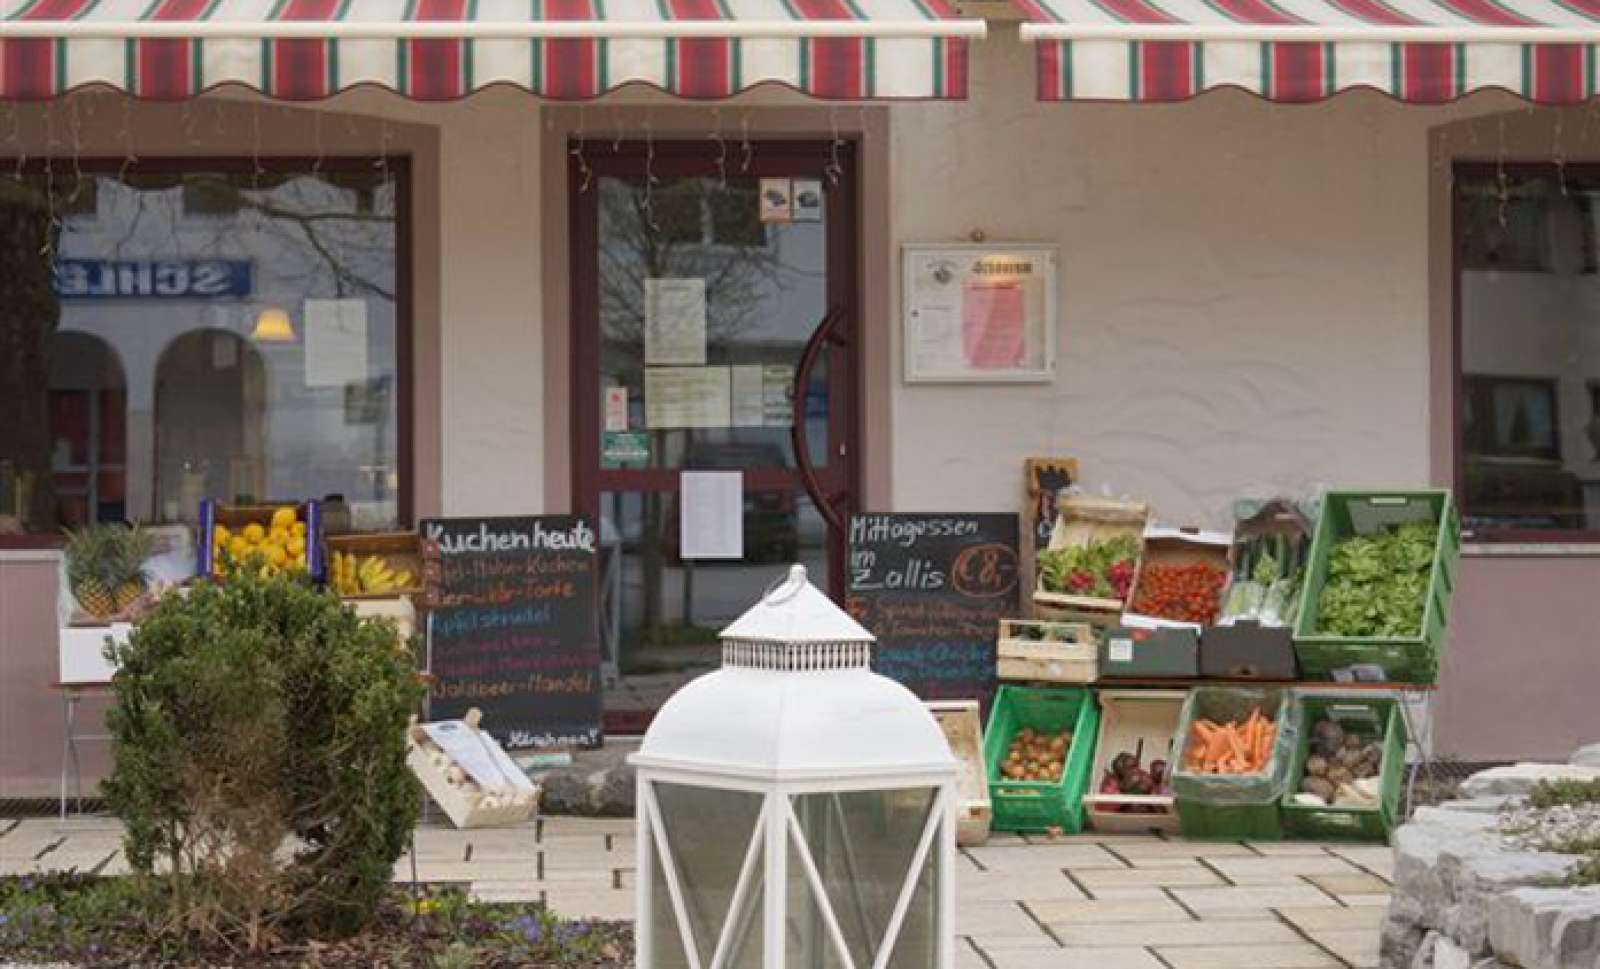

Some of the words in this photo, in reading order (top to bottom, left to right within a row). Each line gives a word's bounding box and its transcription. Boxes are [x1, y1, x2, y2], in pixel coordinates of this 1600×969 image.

[427, 521, 529, 553] Kuchen
[533, 519, 596, 552] heute
[849, 516, 979, 547] Mittagessen
